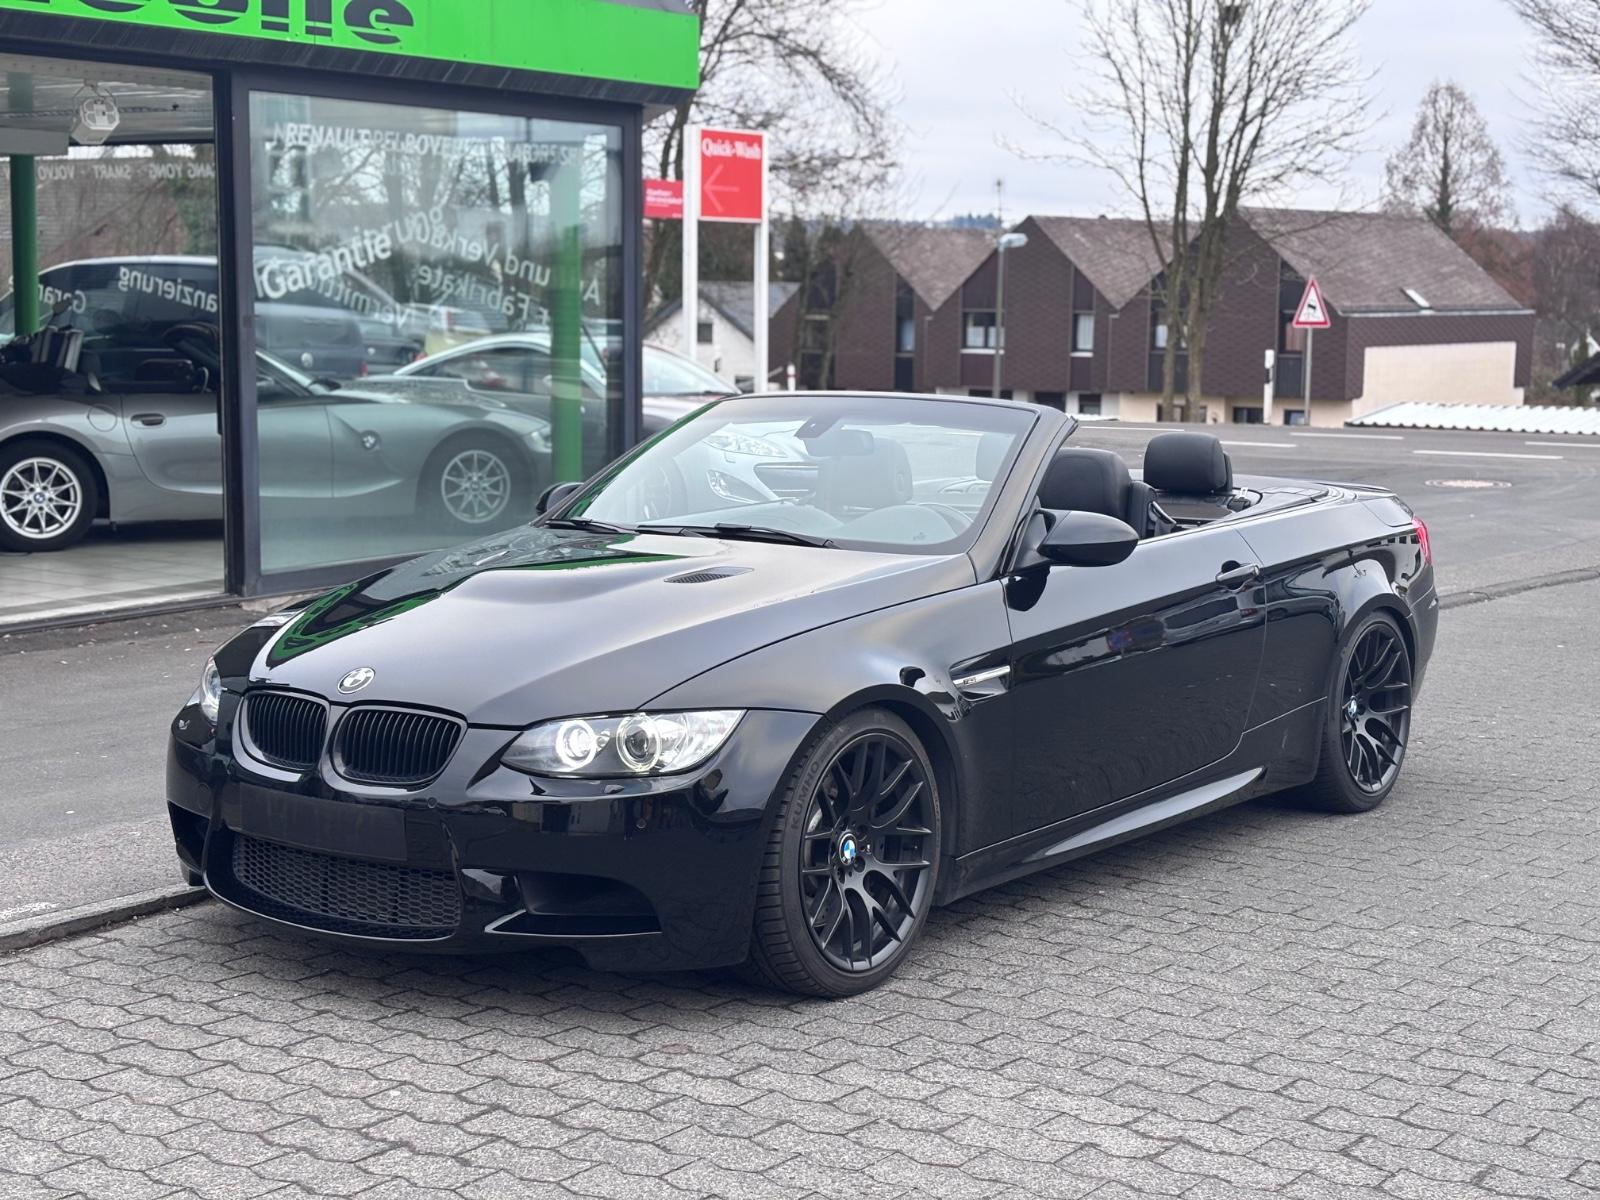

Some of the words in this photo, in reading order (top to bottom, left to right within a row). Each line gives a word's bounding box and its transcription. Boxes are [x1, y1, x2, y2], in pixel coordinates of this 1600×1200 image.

[285, 122, 368, 148] RENAULT
[261, 232, 393, 299] Garantie
[790, 761, 820, 829] KUMHO
